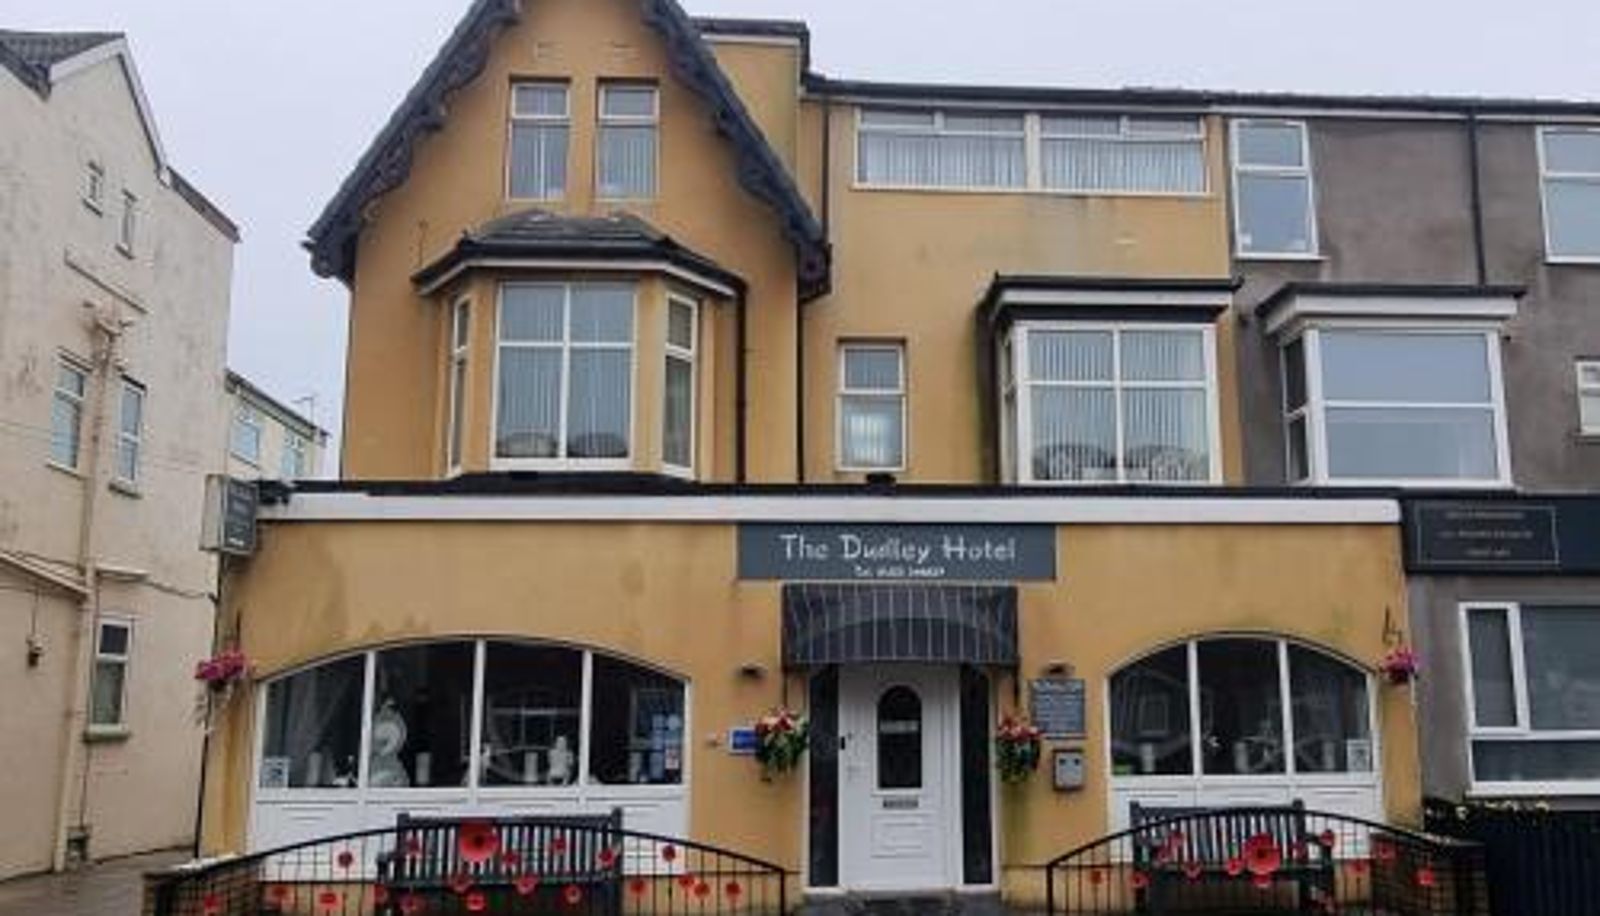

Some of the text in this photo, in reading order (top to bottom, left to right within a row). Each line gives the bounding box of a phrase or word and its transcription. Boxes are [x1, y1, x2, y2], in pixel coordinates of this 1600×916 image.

[779, 533, 1015, 564] The Dudley Hotel
